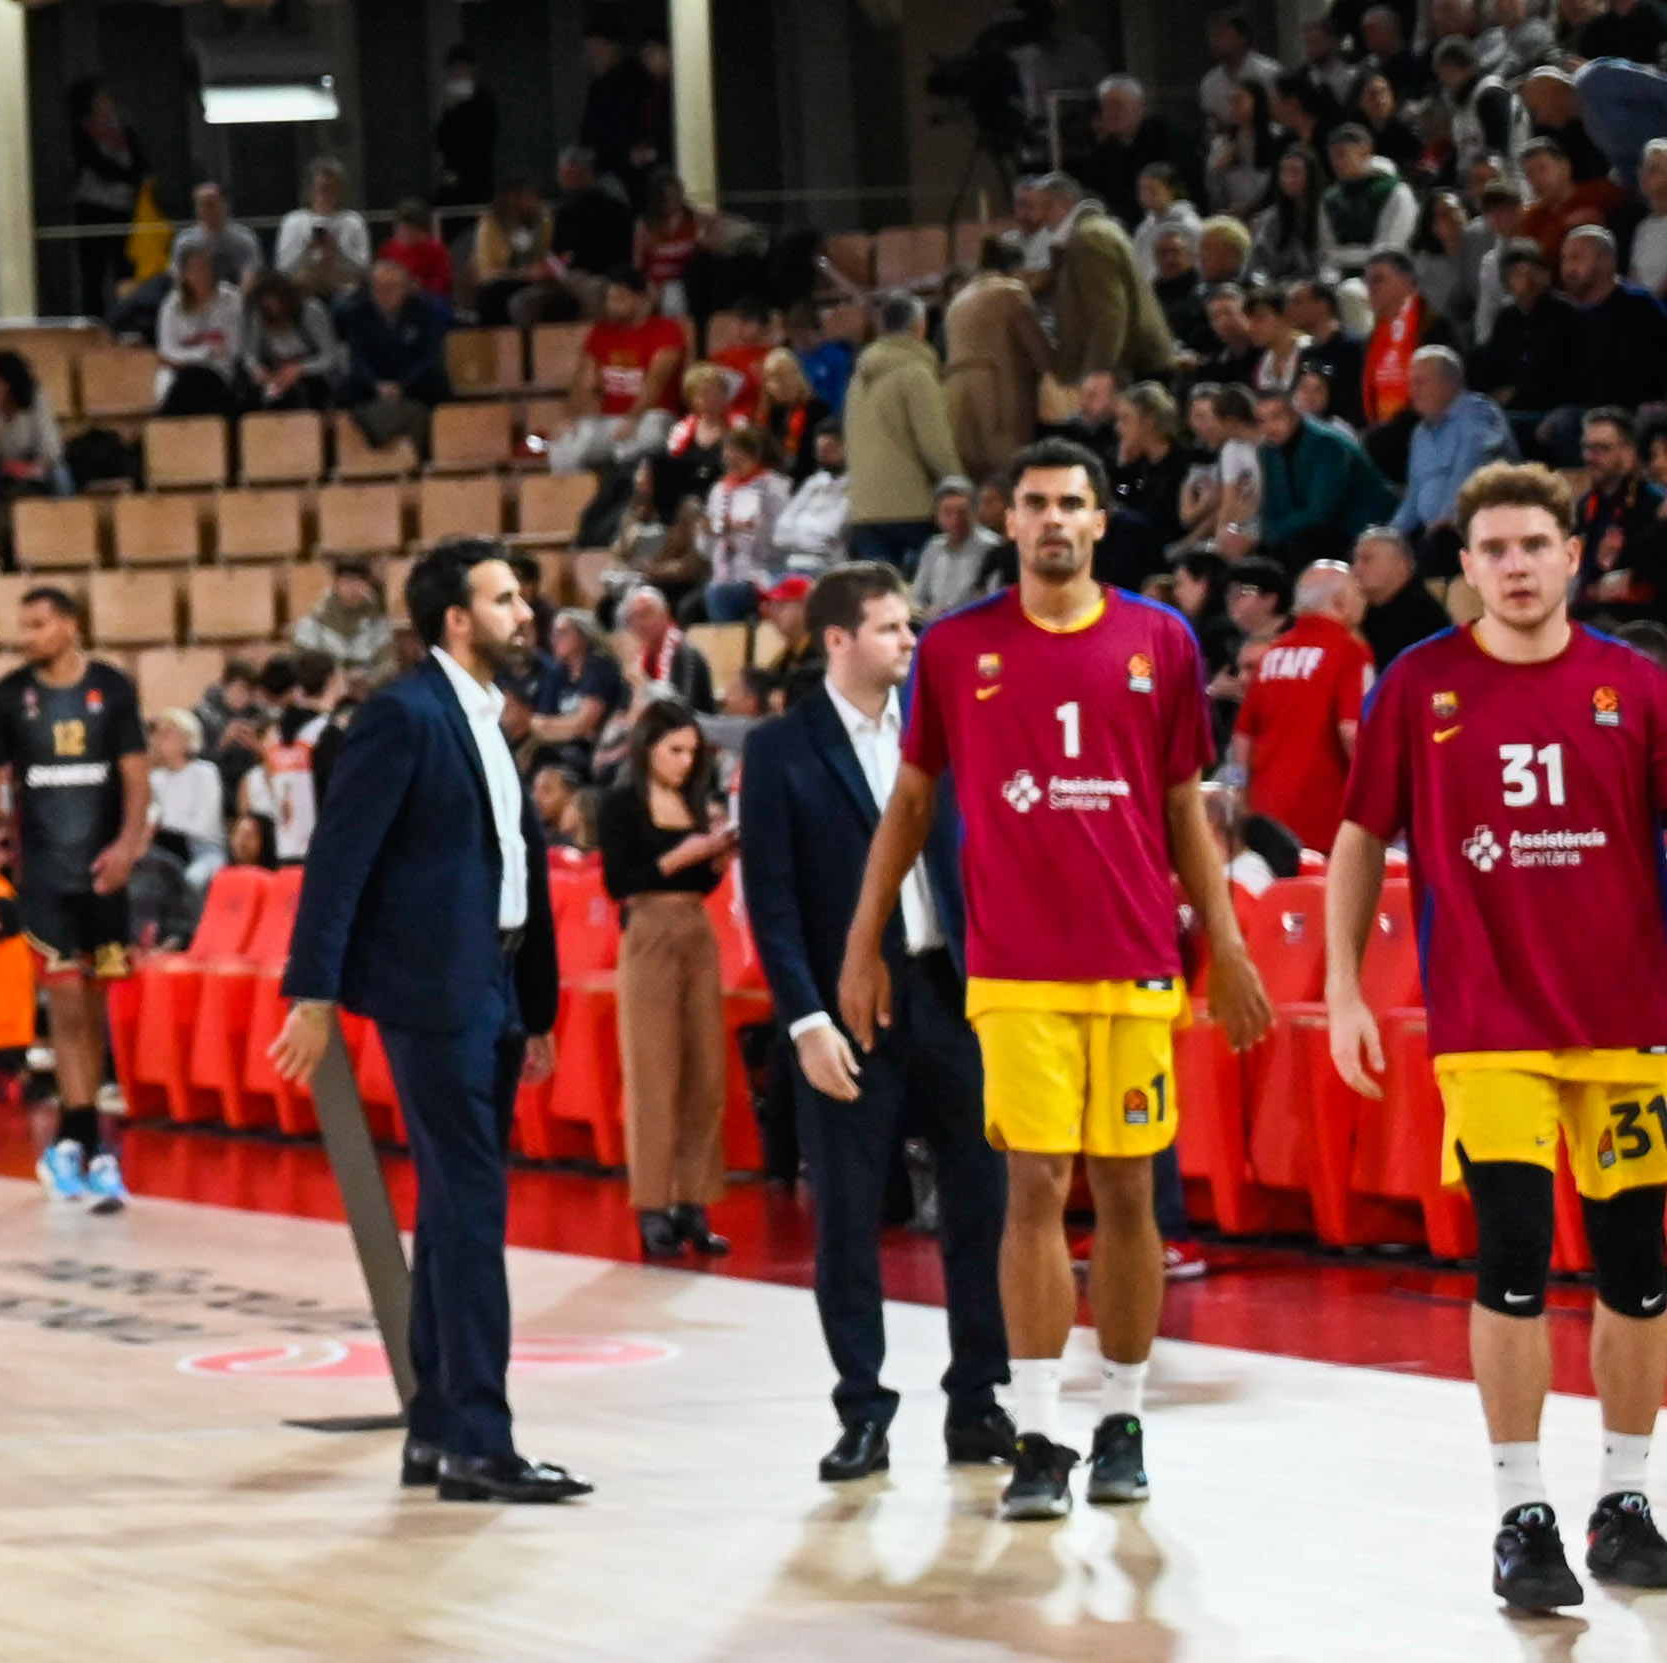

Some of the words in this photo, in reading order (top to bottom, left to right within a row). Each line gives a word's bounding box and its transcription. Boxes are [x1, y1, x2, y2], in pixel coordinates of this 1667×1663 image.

[1056, 701, 1081, 759] 1
[1498, 743, 1566, 808] 31
[1151, 1073, 1165, 1122] 1
[1610, 1094, 1667, 1160] 31
